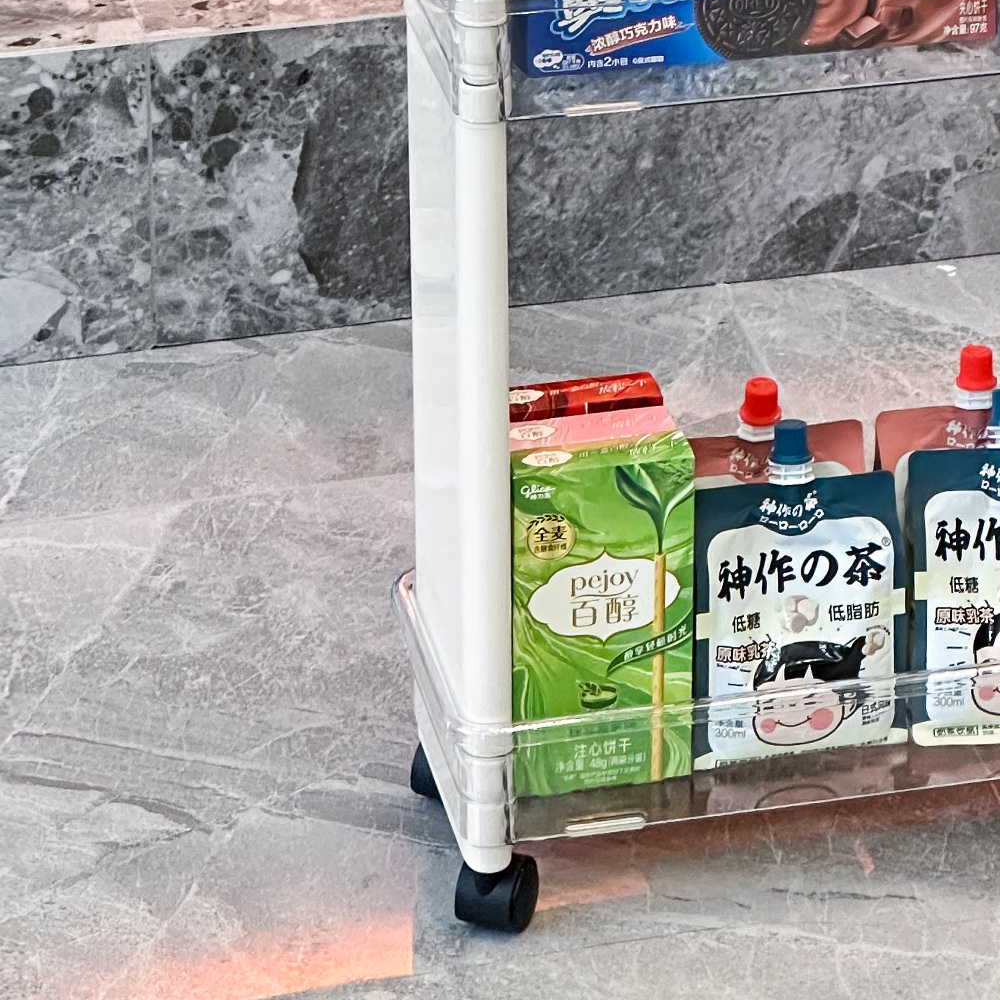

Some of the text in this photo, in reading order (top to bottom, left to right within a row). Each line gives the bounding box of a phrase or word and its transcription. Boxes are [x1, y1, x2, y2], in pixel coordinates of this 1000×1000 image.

[591, 14, 678, 51] 浓醇巧克力味
[533, 525, 568, 542] 全麦
[717, 542, 886, 602] 神作の茶
[570, 569, 640, 598] pejoy
[949, 575, 979, 594] 低糖
[571, 594, 639, 628] 百醇
[732, 601, 880, 634] 低糖 低脂肪
[934, 607, 995, 626] 原味乳茶
[933, 696, 965, 707] 300ml
[715, 728, 746, 739] 300ml
[574, 737, 632, 759] 注心饼干
